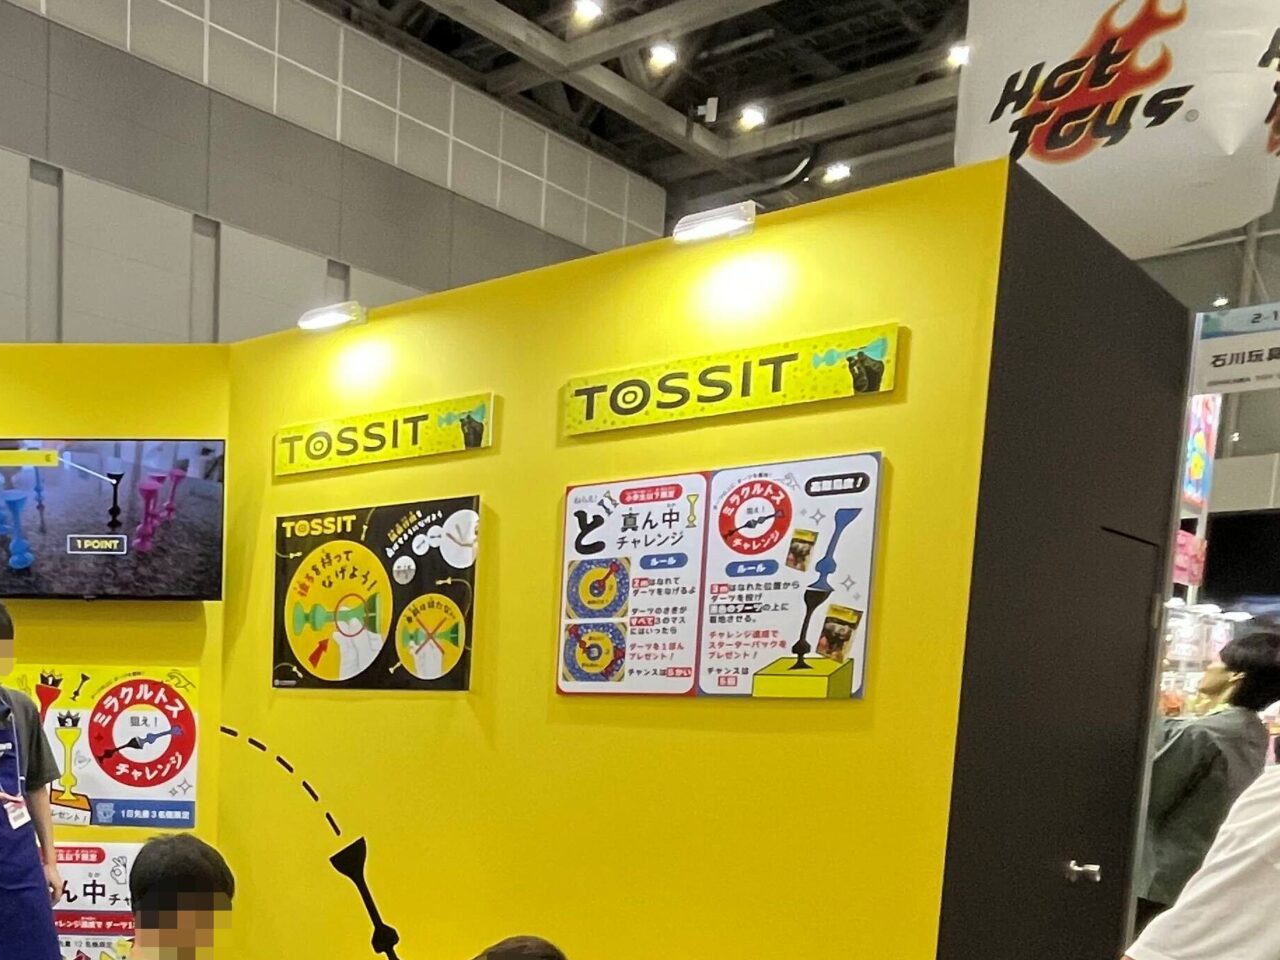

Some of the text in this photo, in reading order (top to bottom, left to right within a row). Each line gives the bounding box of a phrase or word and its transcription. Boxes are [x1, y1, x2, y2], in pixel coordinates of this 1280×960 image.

[575, 352, 799, 421] TOSSIT
[280, 414, 429, 464] TOSSIT
[722, 483, 785, 516] ミラクルトス
[282, 515, 357, 538] TOSSIT
[621, 509, 680, 532] 真ん中
[84, 540, 120, 549] POINT
[617, 531, 684, 550] チャレンジ
[732, 530, 780, 551] チャレンジ
[737, 562, 766, 573] ルール
[94, 684, 185, 727] ミラクルトス
[130, 715, 158, 728] 狙え！
[116, 752, 183, 781] チャレンジ
